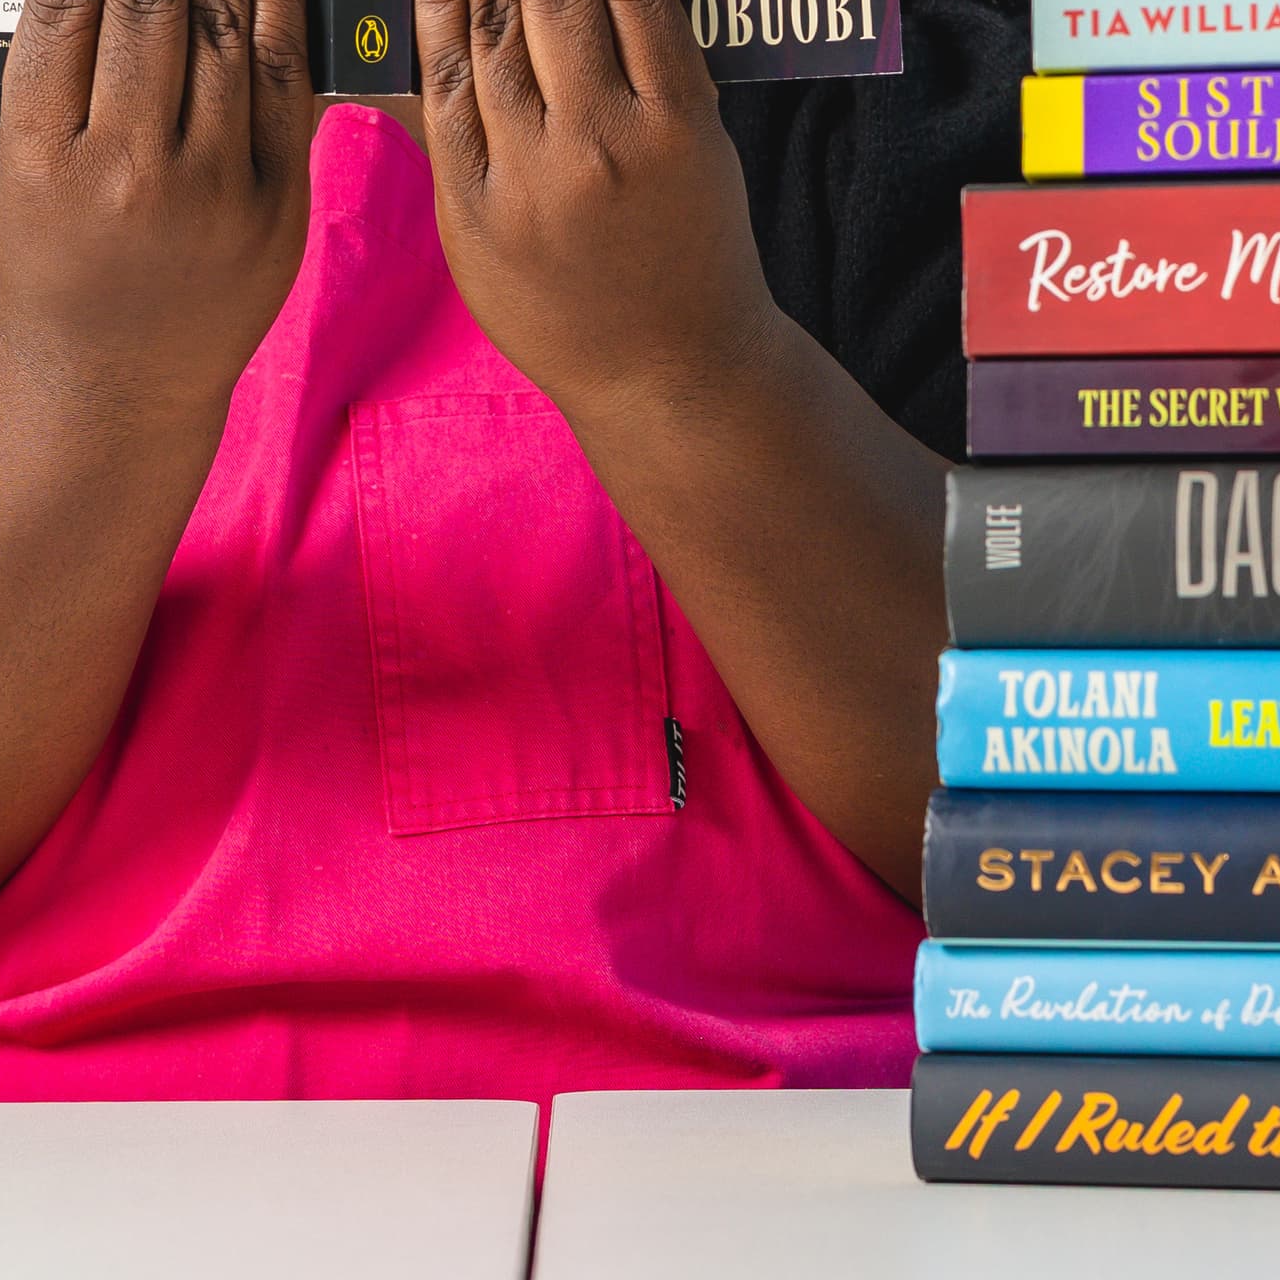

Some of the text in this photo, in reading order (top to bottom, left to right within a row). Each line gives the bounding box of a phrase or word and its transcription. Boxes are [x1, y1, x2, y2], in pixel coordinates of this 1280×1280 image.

[1064, 8, 1130, 37] TIA
[1019, 229, 1207, 312] Restore
[1078, 389, 1141, 428] THE
[1148, 388, 1269, 427] SECRET
[985, 504, 1022, 570] WOLFE
[998, 671, 1158, 719] TOLANI
[982, 727, 1178, 774] AKINOLA
[976, 848, 1230, 895] STACEY
[946, 987, 991, 1018] The
[1001, 975, 1193, 1024] Revelation
[1200, 1000, 1231, 1031] of
[945, 1088, 1021, 1160] If
[1015, 1090, 1063, 1151] I
[1055, 1090, 1251, 1154] Ruled
